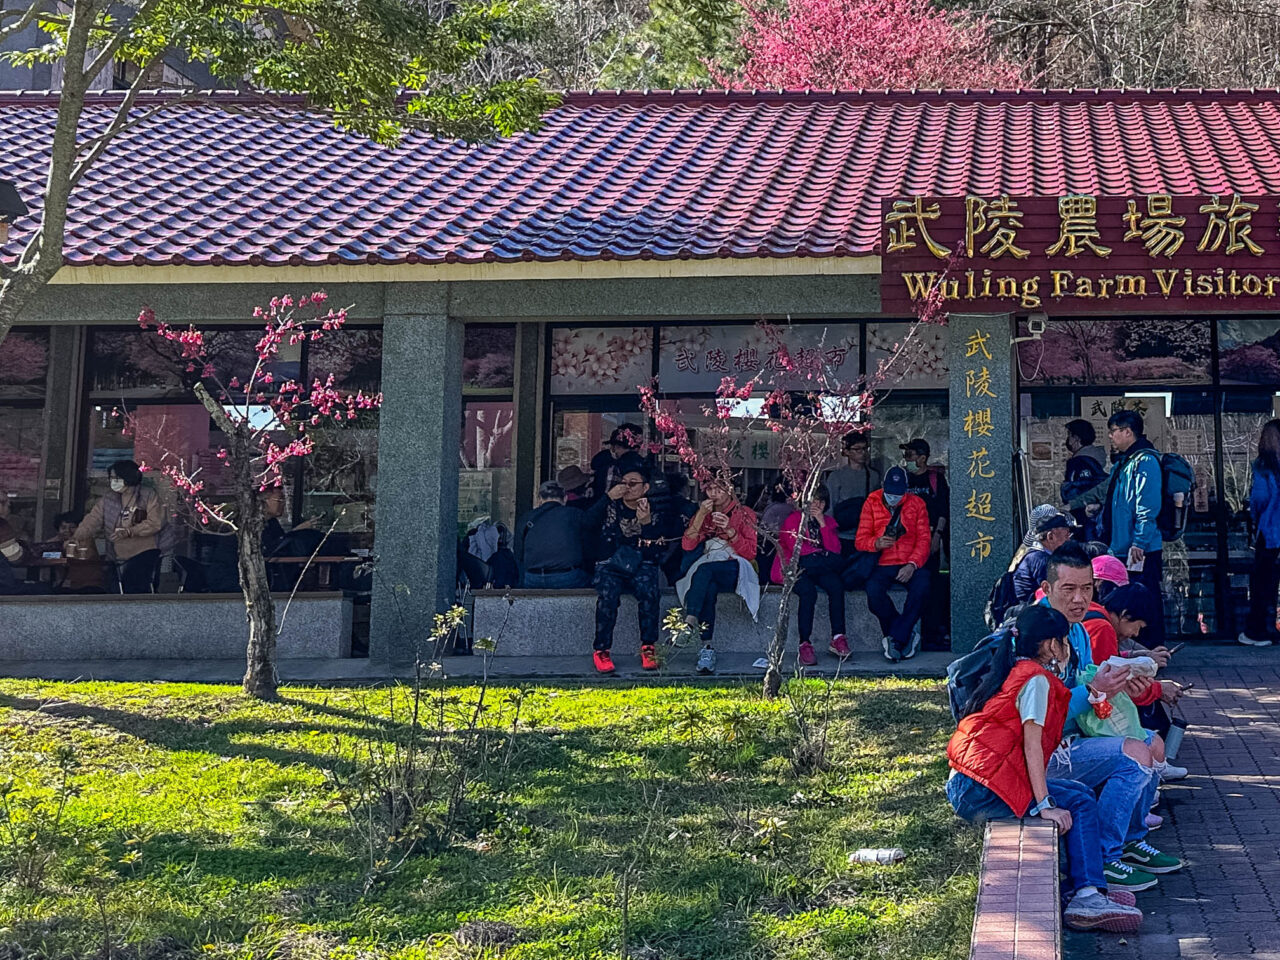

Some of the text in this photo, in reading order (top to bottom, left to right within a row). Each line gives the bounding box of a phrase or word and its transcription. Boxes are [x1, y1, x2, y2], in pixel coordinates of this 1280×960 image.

[901, 270, 1041, 308] Wuling
[1049, 270, 1147, 298] Farm
[1152, 268, 1279, 298] Visitor
[962, 328, 998, 563] 武陵櫻花超市
